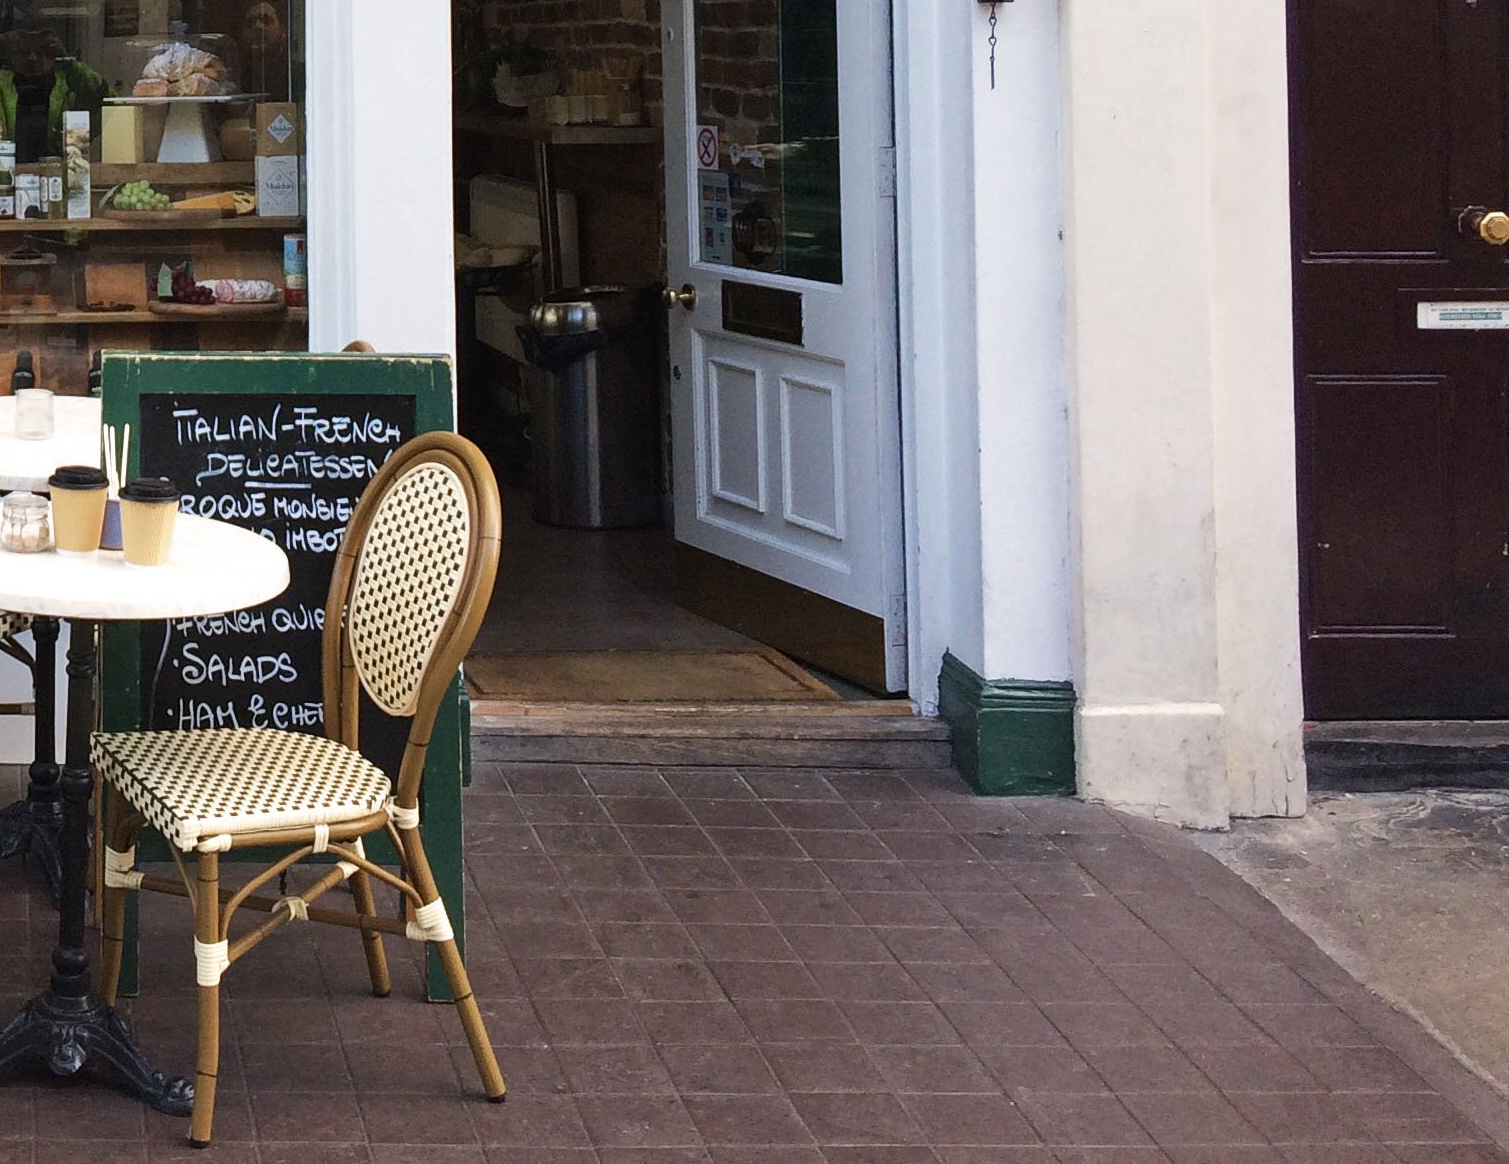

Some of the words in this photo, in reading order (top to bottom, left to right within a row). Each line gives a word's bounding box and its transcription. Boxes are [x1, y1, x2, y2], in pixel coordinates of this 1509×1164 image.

[171, 488, 266, 519] ROQUE
[271, 603, 348, 632] QUIC
[182, 642, 298, 687] SALADS
[179, 697, 239, 730] HAM
